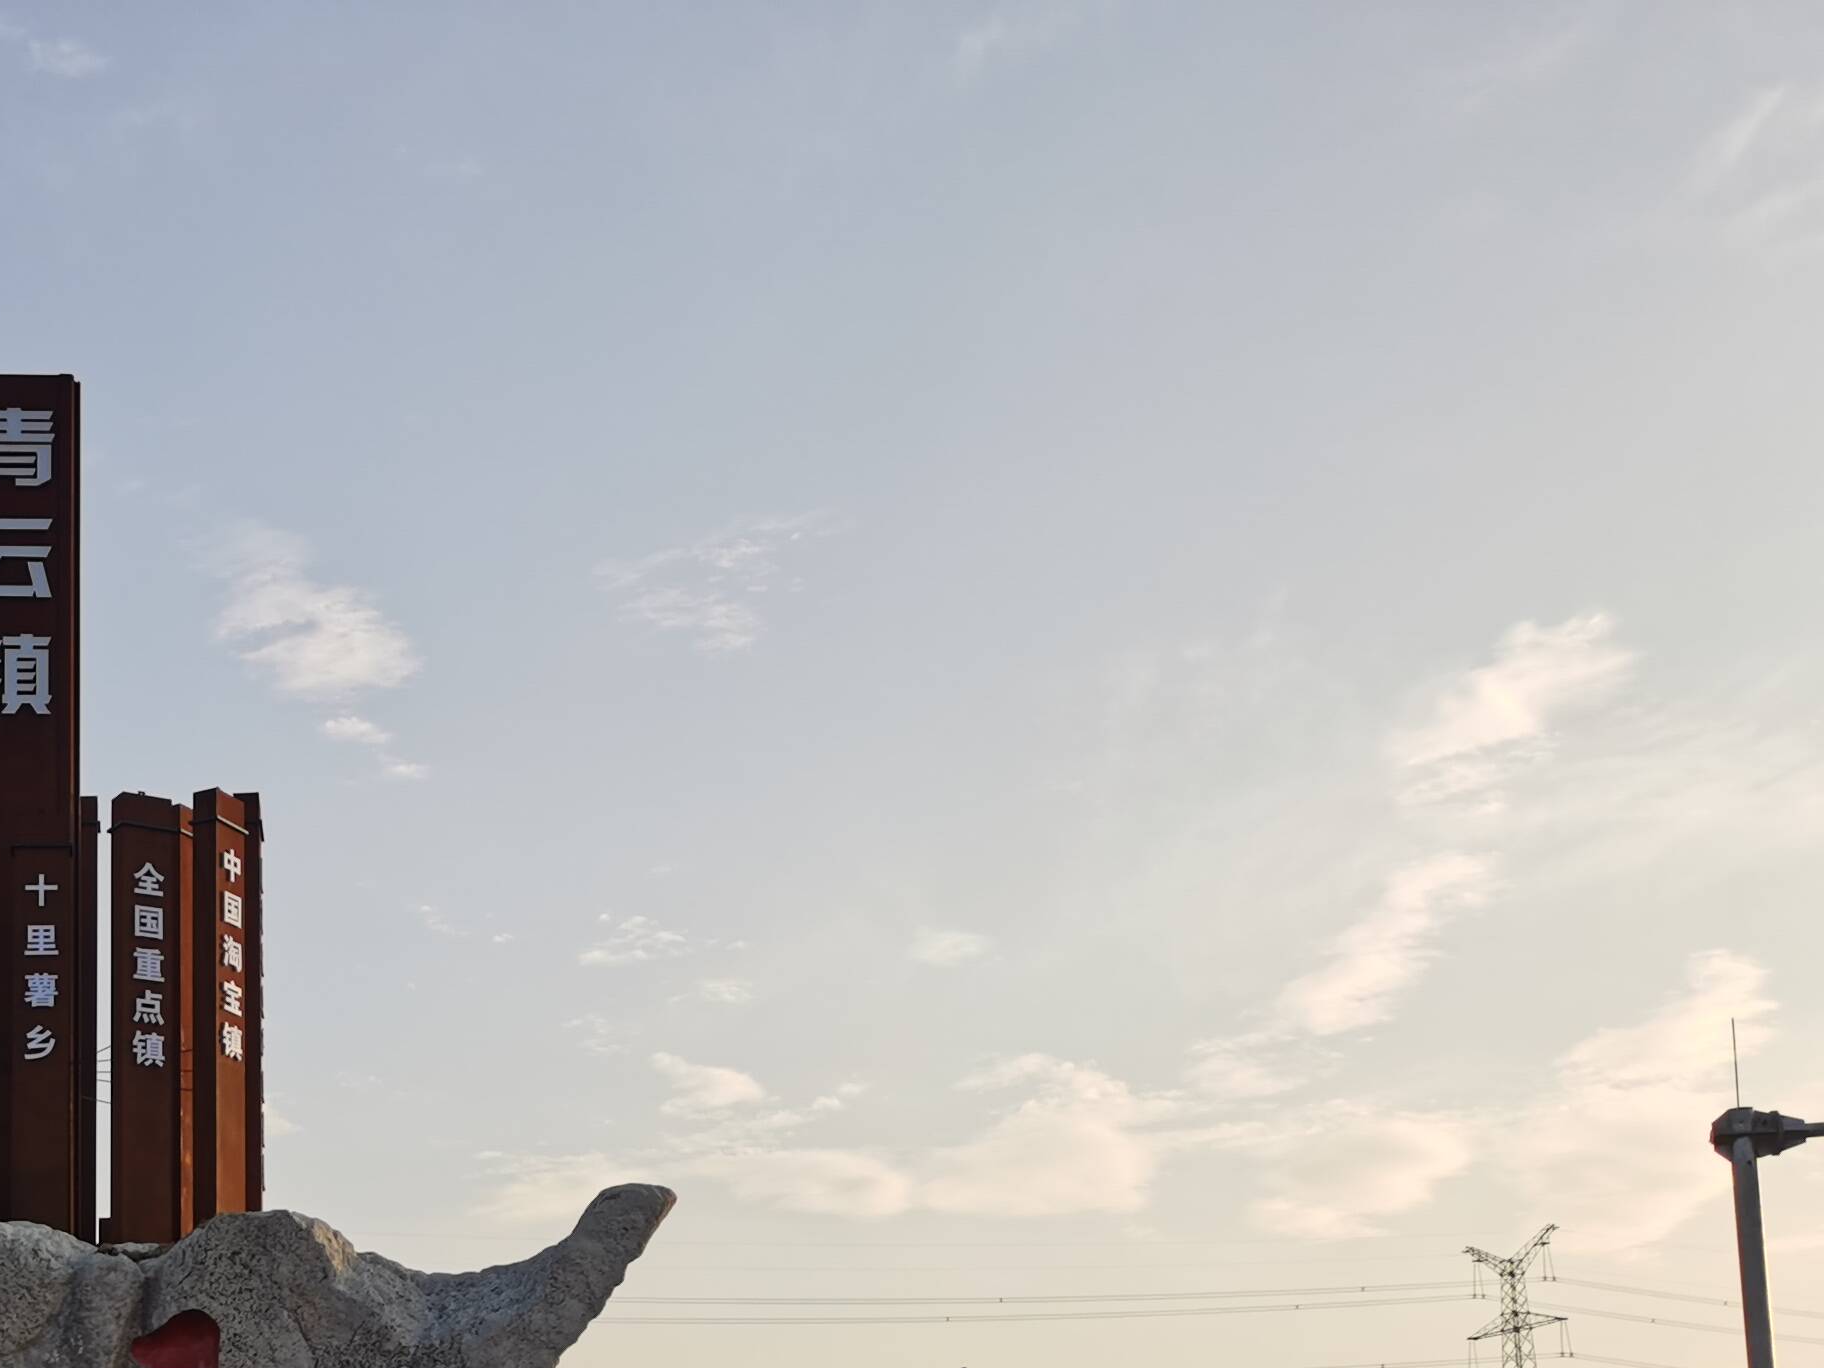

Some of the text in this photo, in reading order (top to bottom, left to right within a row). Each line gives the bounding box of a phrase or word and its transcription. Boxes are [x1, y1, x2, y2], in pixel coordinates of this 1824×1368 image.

[24, 874, 59, 1060] 十里薯乡
[132, 862, 166, 1067] 全国重点镇
[222, 848, 244, 1062] 中国淘宝镇
